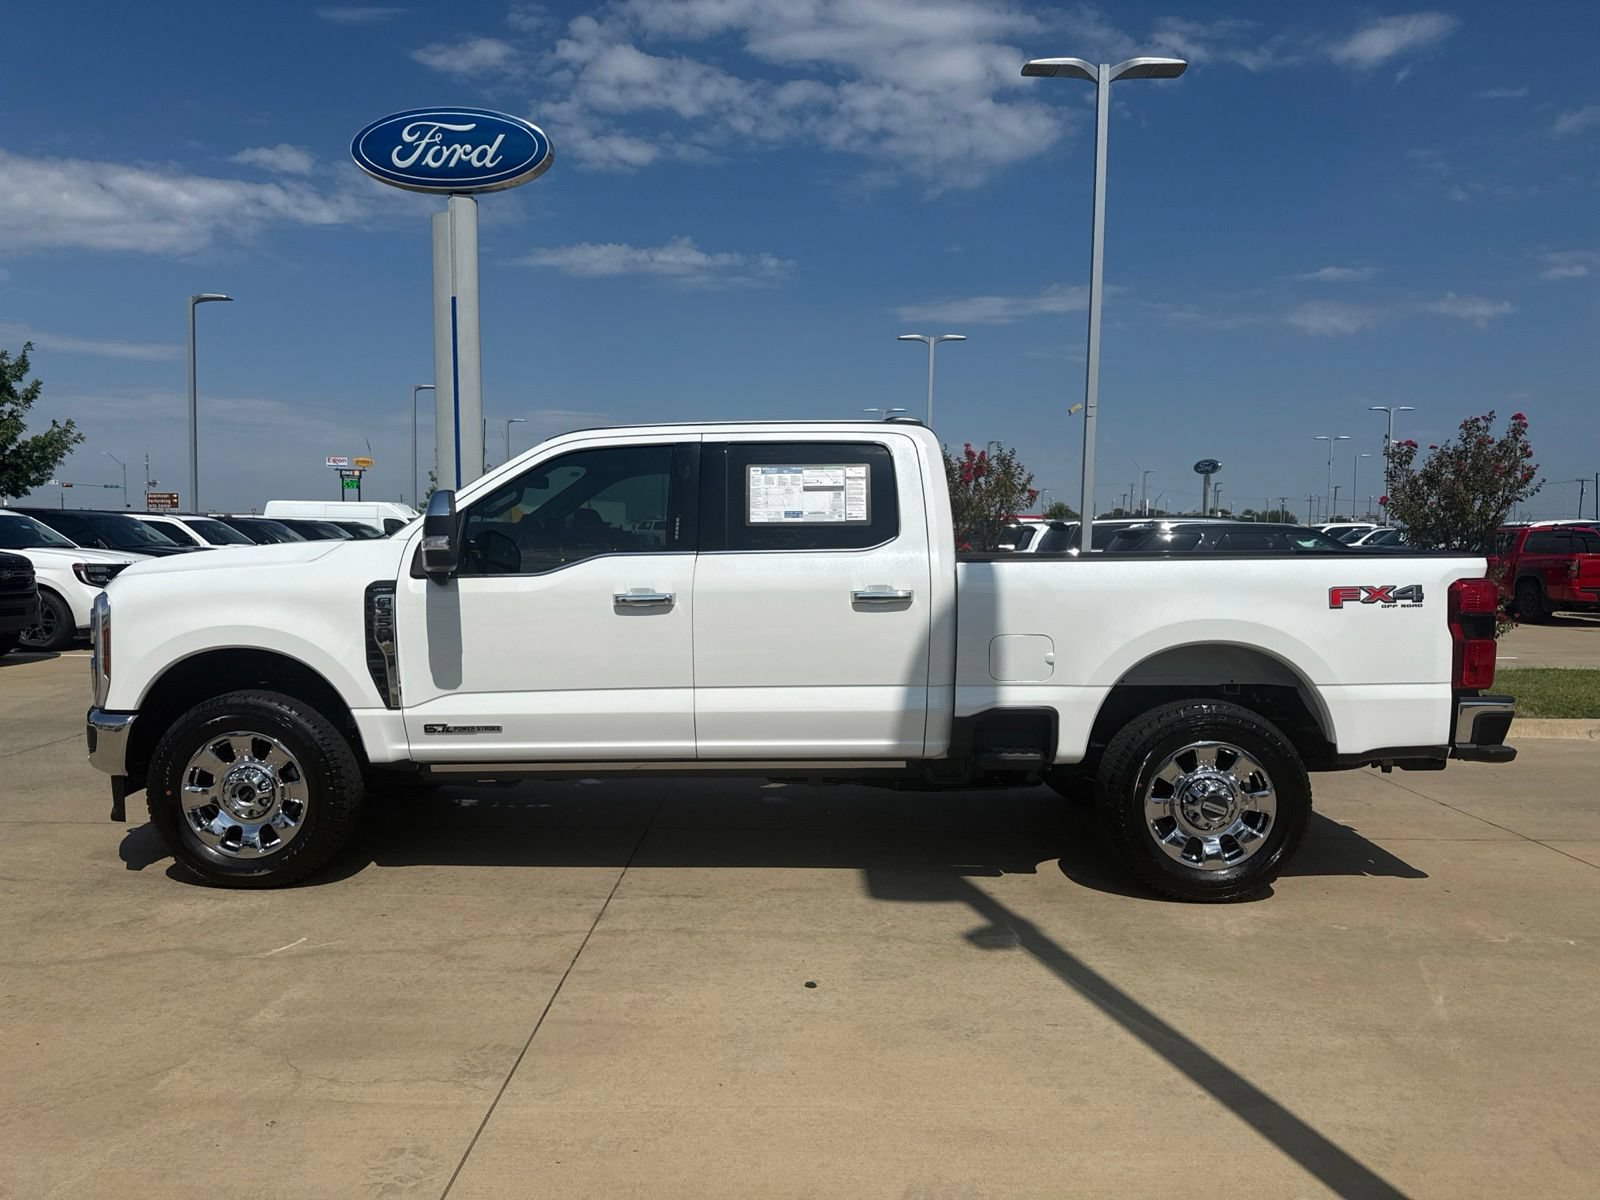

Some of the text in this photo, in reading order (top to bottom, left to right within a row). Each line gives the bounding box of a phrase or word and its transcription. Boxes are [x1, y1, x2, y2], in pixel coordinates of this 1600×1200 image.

[391, 121, 505, 168] Ford
[327, 456, 347, 464] Exxon
[1329, 585, 1424, 609] FX4
